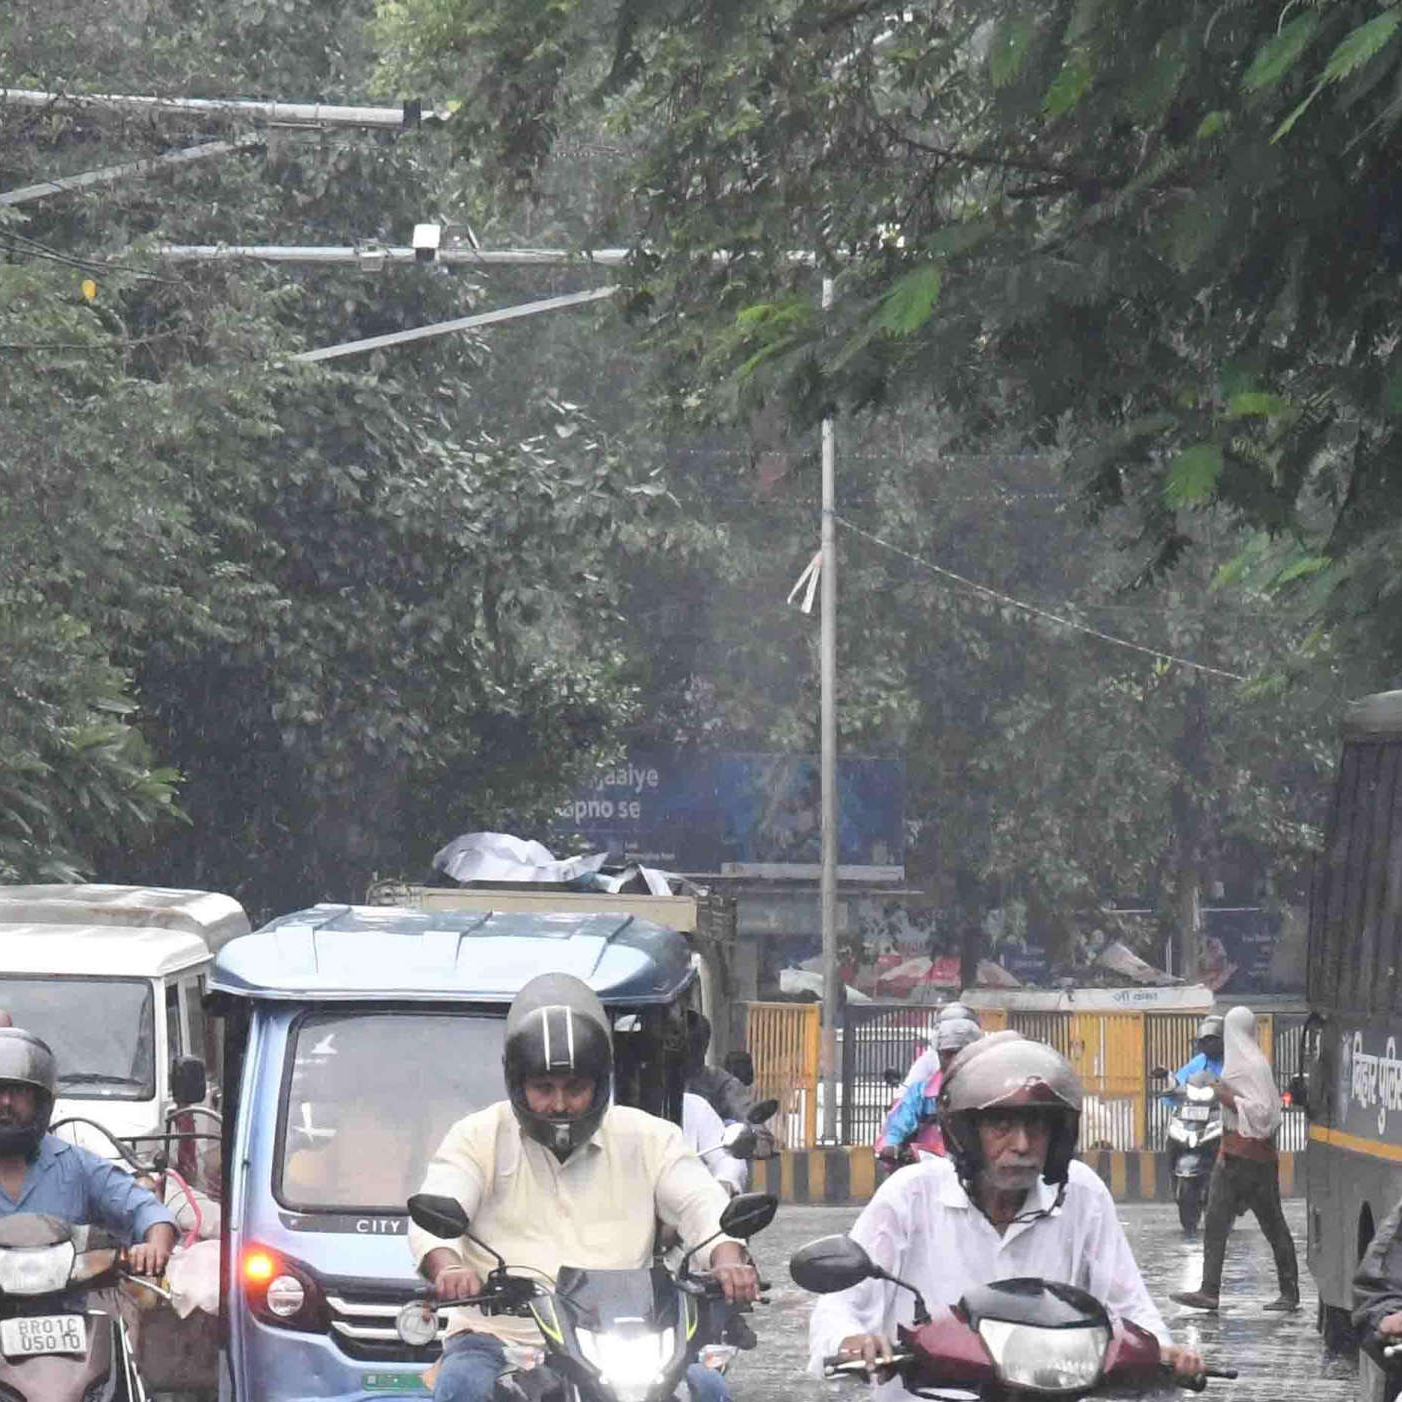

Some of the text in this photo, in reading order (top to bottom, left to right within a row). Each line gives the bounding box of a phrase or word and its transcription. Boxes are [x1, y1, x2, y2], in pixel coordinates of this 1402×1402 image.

[618, 801, 640, 818] se
[1351, 1031, 1378, 1109] बिहार
[356, 1219, 400, 1233] CITY
